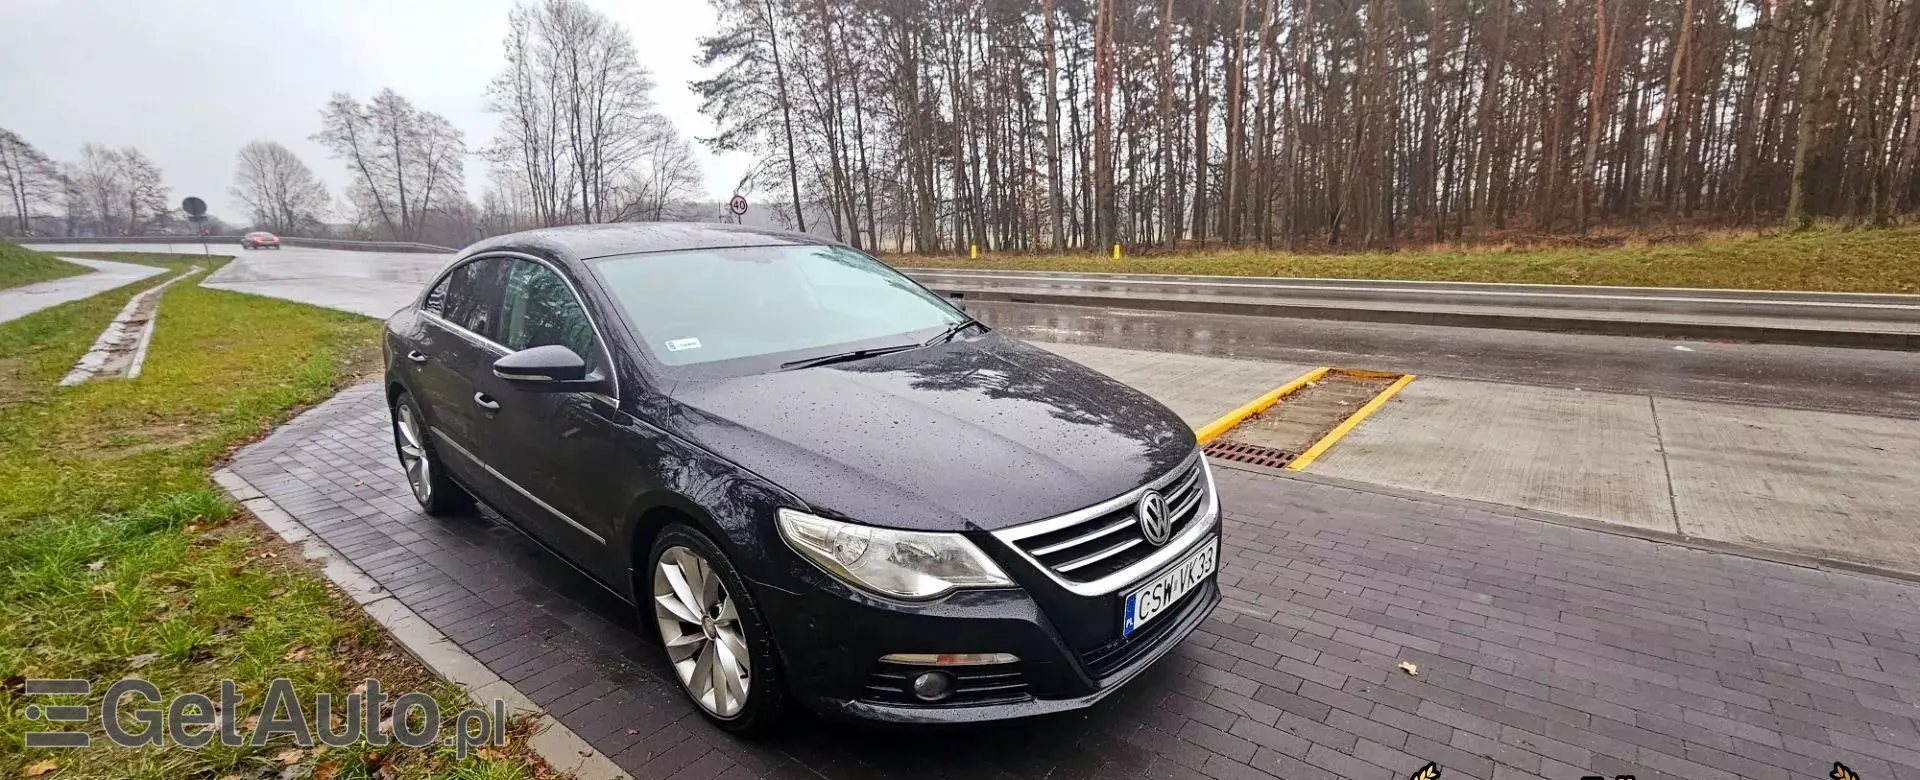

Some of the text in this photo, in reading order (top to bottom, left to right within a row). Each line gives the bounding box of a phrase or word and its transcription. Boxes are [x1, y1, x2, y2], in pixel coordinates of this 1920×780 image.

[733, 200, 746, 210] 40
[1139, 547, 1213, 620] CSW VK33
